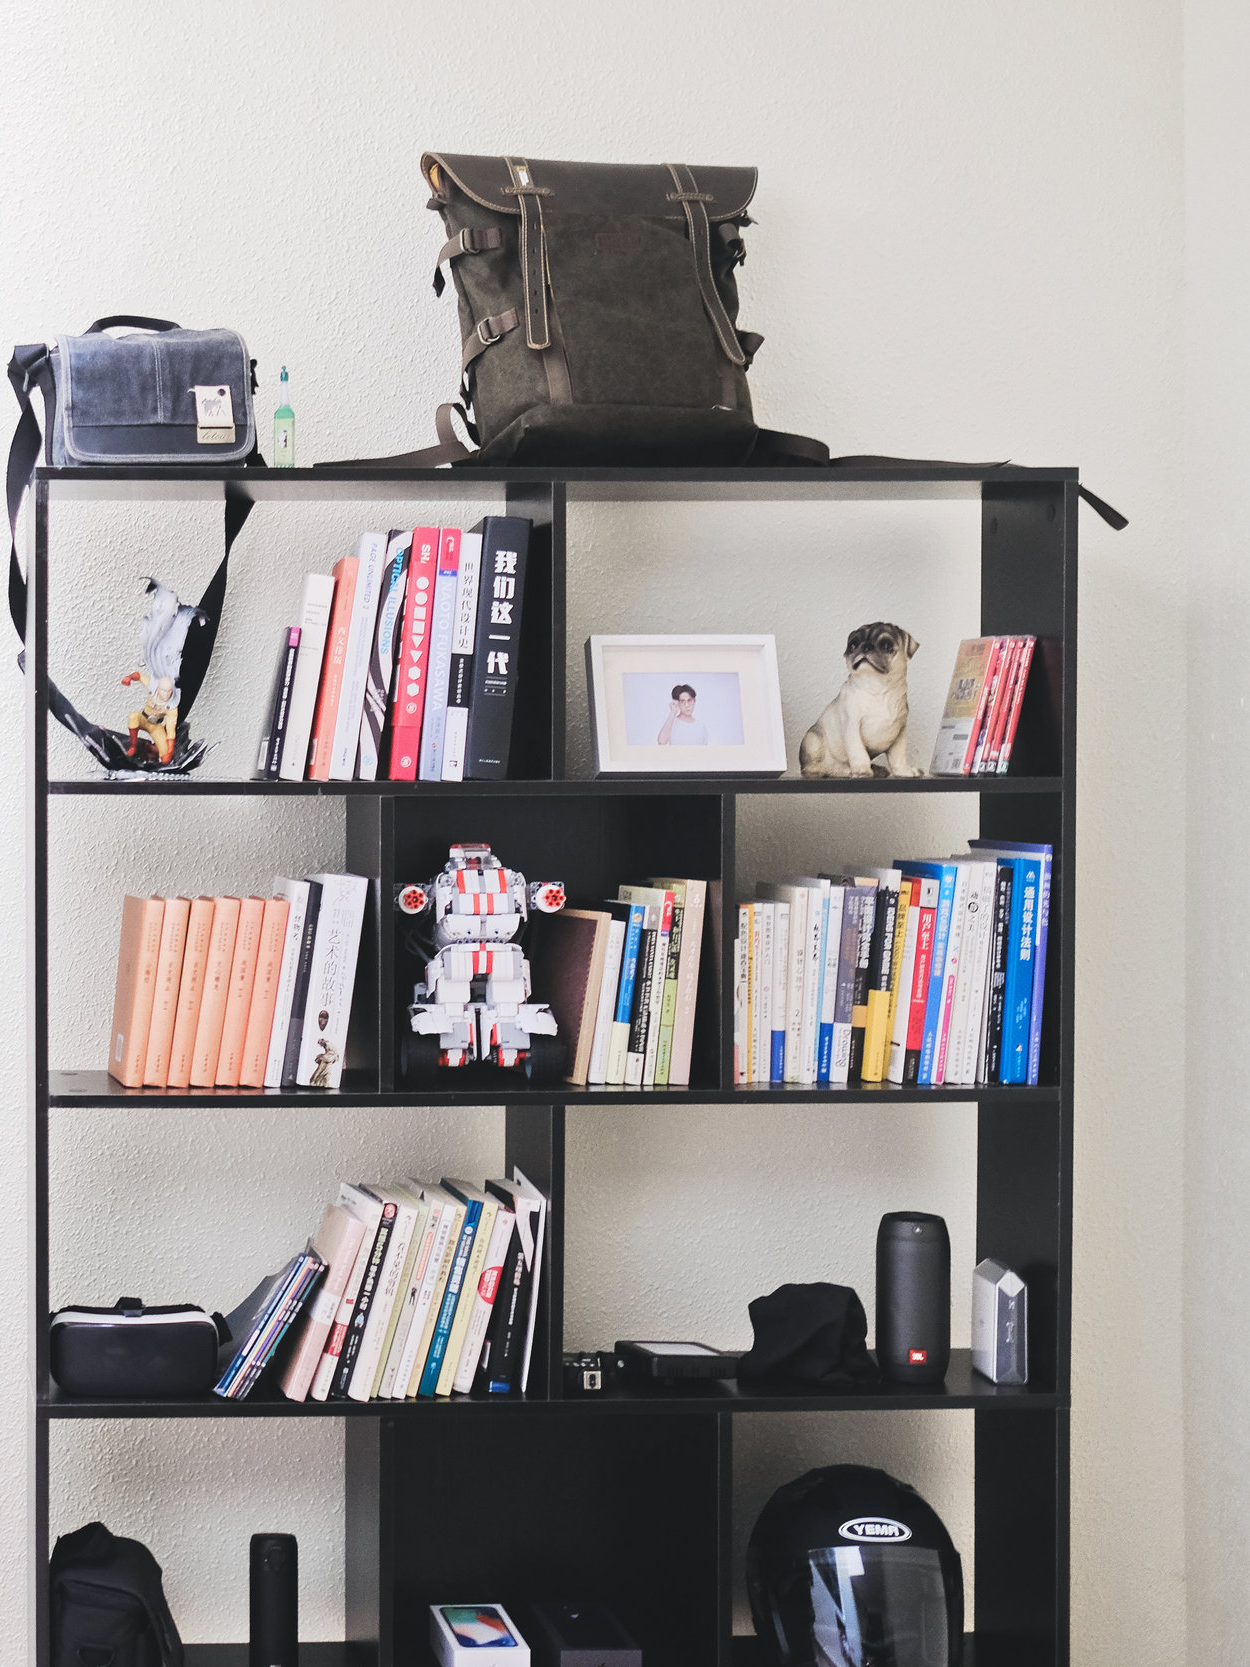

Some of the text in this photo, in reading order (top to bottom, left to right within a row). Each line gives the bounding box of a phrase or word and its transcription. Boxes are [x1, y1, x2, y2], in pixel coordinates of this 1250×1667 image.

[380, 547, 406, 655] OPTICAL ILLUSIONS
[438, 582, 453, 634] NAOTO
[457, 562, 473, 650] 世界现代设计史
[485, 550, 518, 675] 我们这一代
[432, 635, 450, 712] FUKASAWA
[920, 913, 932, 951] 用户至上
[1019, 886, 1035, 962] 通用设计法则
[321, 929, 342, 1008] 艺术的故事
[912, 1352, 924, 1361] JBL
[853, 1523, 900, 1537] YEMA
